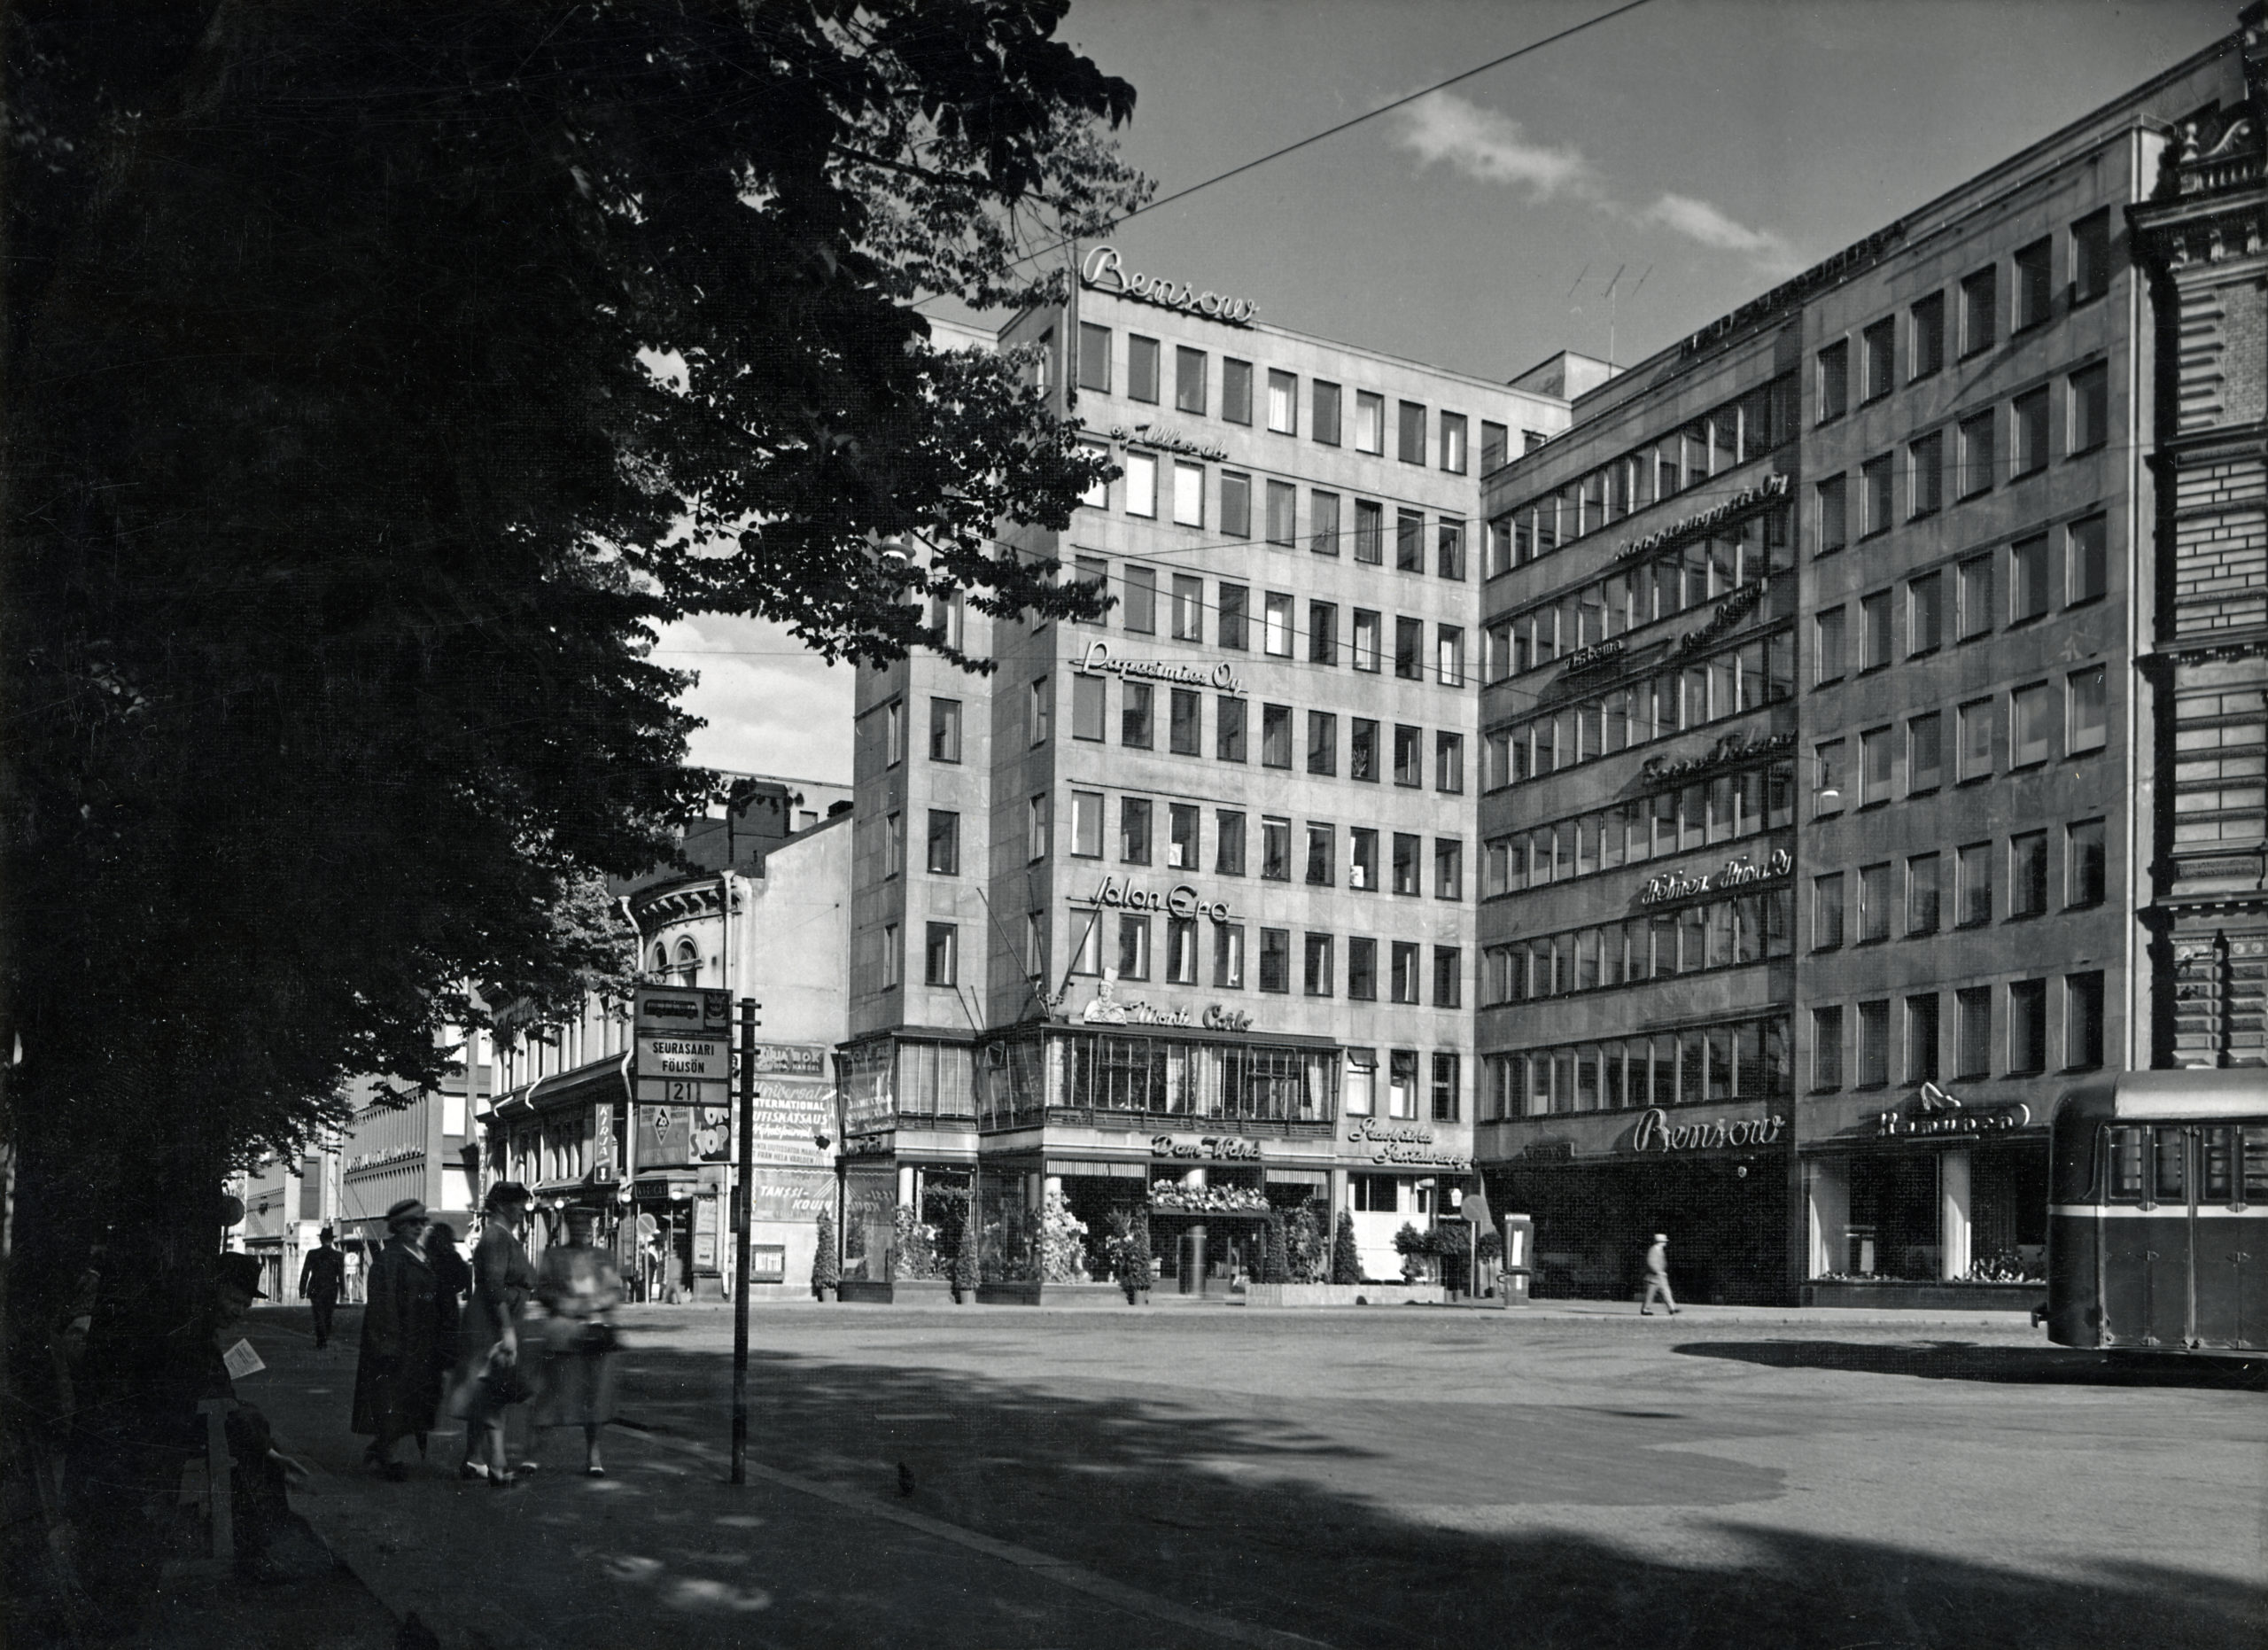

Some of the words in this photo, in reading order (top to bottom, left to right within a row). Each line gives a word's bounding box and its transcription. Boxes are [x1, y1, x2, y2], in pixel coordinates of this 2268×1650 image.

[1083, 245, 1260, 322] Bensow
[1213, 661, 1244, 697] Oy
[1168, 884, 1231, 923] Era
[1132, 1000, 1192, 1027] Monte
[1202, 1004, 1254, 1031] Carlo
[652, 1041, 715, 1056] SEURASAARI
[662, 1059, 705, 1074] FÖLISÖN
[673, 1082, 692, 1101] 21
[753, 1098, 825, 1111] NTERNATIONAL
[599, 1106, 610, 1156] KIRJA
[753, 1110, 827, 1125] UTISKATSAUS
[1634, 1108, 1785, 1153] Bensow
[690, 1125, 729, 1157] STOP
[759, 1186, 810, 1198] TANSSI-
